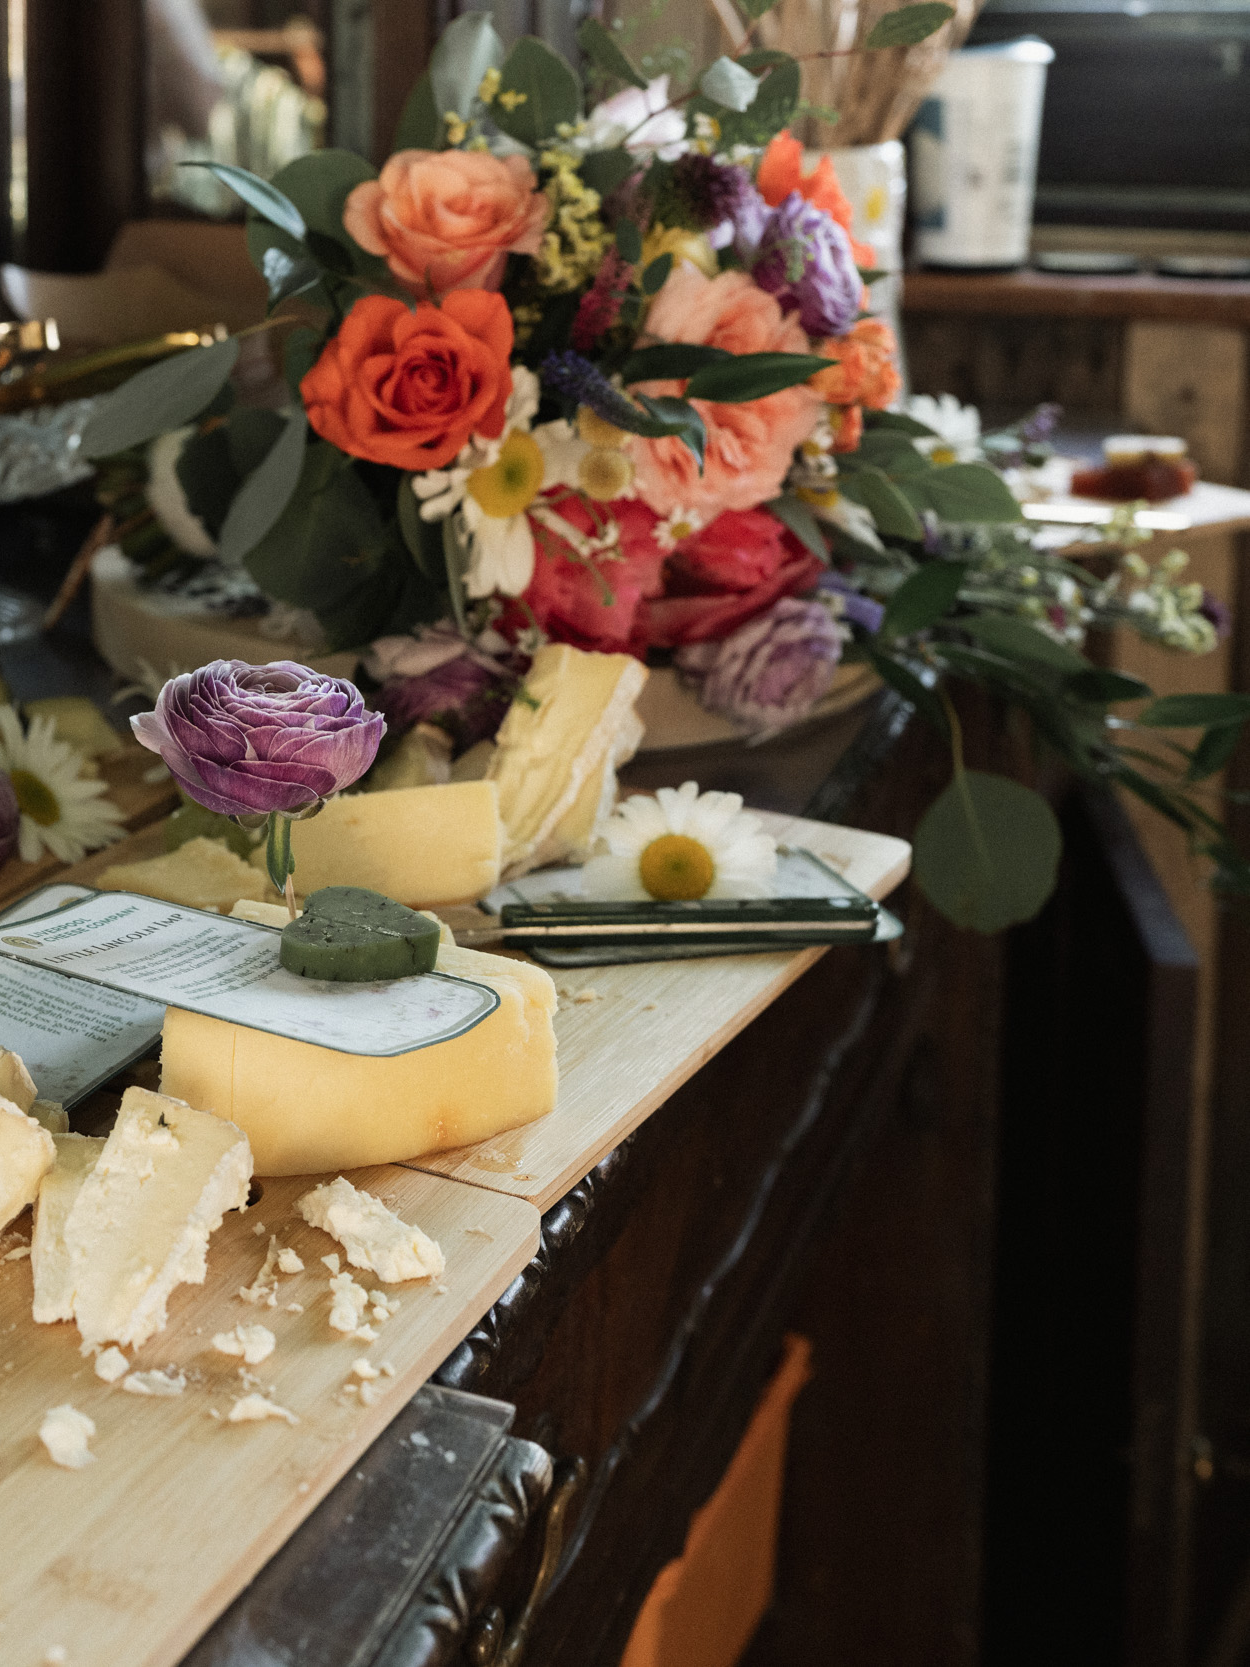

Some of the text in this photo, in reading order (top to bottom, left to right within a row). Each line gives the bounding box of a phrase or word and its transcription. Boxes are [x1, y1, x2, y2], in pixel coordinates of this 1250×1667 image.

[27, 917, 92, 939] LIVERPOOL
[43, 904, 140, 944] CHEESE COMPANY
[43, 913, 184, 965] LITTLE LINCOLN IMP
[38, 998, 72, 1015] bloomy
[84, 1030, 108, 1043] than
